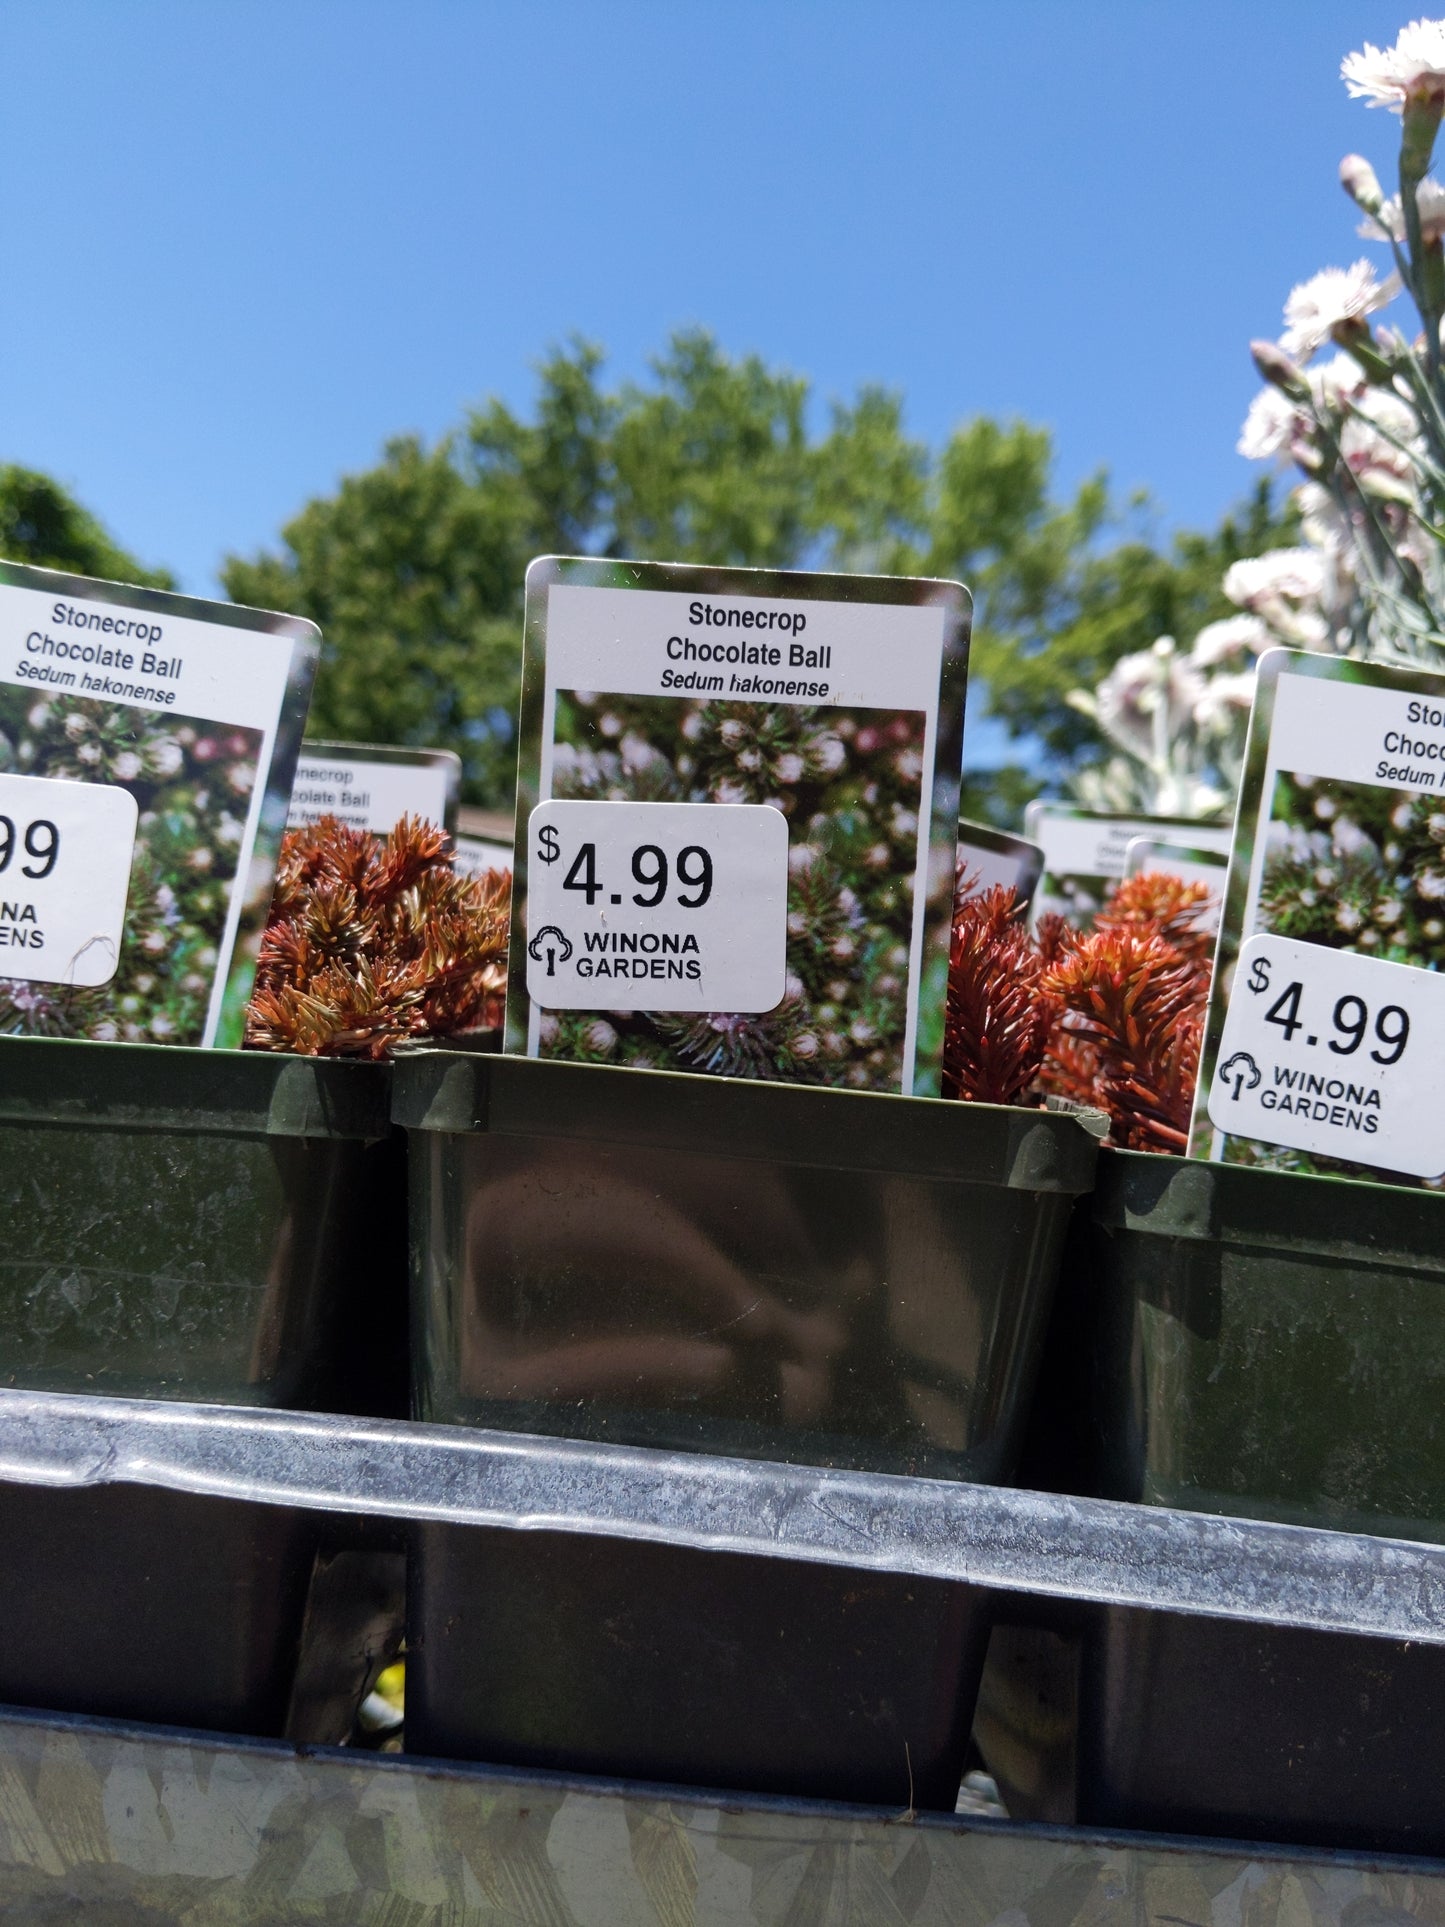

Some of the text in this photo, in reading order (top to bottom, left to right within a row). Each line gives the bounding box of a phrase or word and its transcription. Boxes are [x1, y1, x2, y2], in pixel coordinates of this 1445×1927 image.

[52, 603, 163, 646] Stonecrop
[689, 602, 807, 637] Stonecrop
[26, 631, 183, 680] Chocolate Ball
[666, 636, 831, 669] Chocolate Ball
[16, 660, 176, 705] Sedum hakonense
[660, 669, 830, 697] Sedum hakonense
[1407, 701, 1445, 728] Sto
[1376, 761, 1435, 786] Sedum
[340, 790, 371, 808] Ball
[537, 825, 713, 908] $4.99
[1, 902, 38, 924] NA
[584, 932, 700, 954] WINONA
[576, 957, 701, 980] GARDENS
[1247, 957, 1410, 1065] $4.99
[1274, 1065, 1381, 1109] WINONA
[1260, 1090, 1380, 1134] GARDENS
